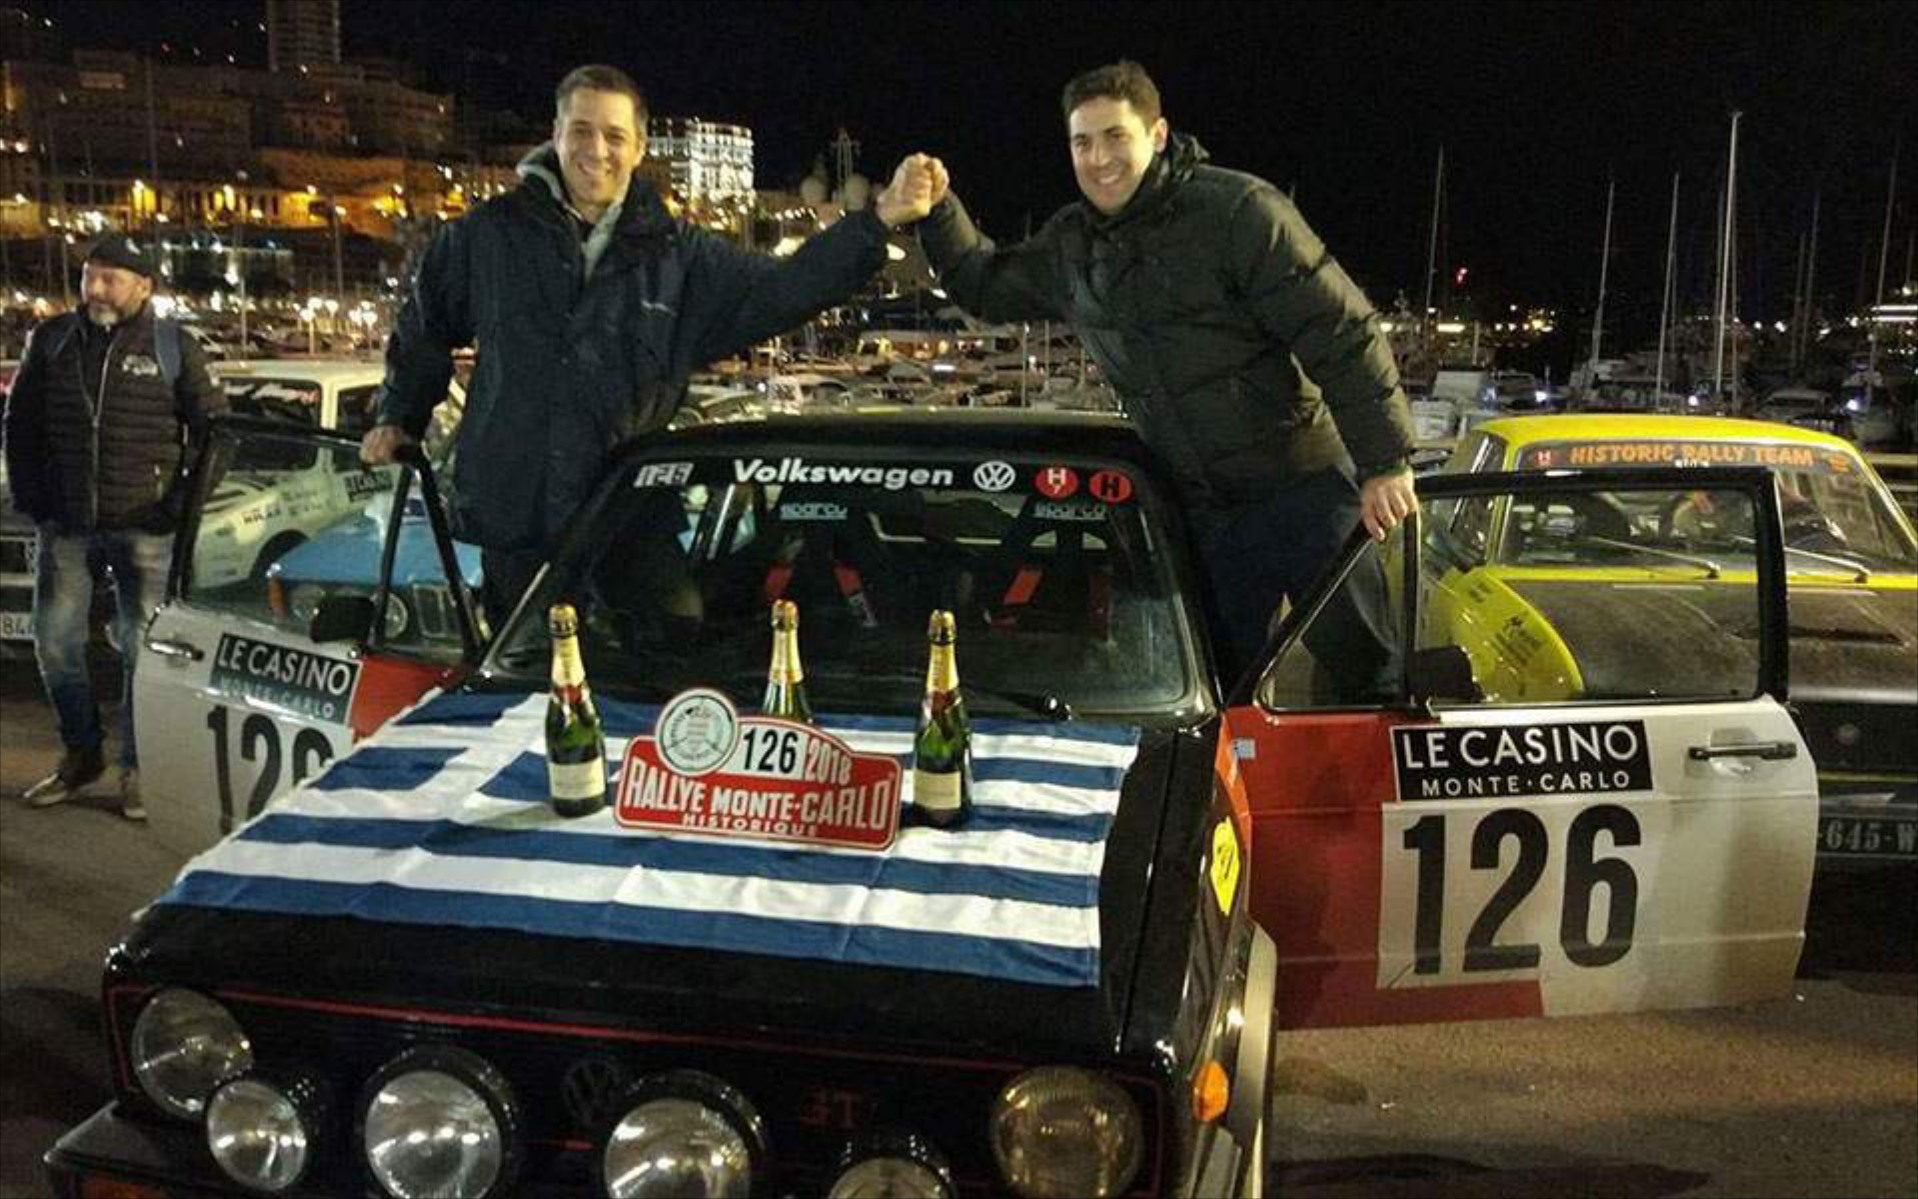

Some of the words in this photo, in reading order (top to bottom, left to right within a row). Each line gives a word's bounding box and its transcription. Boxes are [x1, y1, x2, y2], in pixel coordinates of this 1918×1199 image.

[734, 457, 954, 490] Volkswagen
[1570, 445, 1675, 465] HISTORIC
[1682, 444, 1746, 465] RALLY
[1756, 447, 1814, 466] TEAM
[218, 638, 247, 670] LE
[248, 645, 350, 696] CASINO
[743, 728, 799, 774] 126
[804, 739, 852, 786] 2018
[1403, 732, 1450, 770] LE
[1459, 724, 1639, 768] CASINO
[624, 755, 707, 813] RALLYE
[682, 812, 817, 838] HISTORIQUE
[1402, 803, 1642, 976] 126
